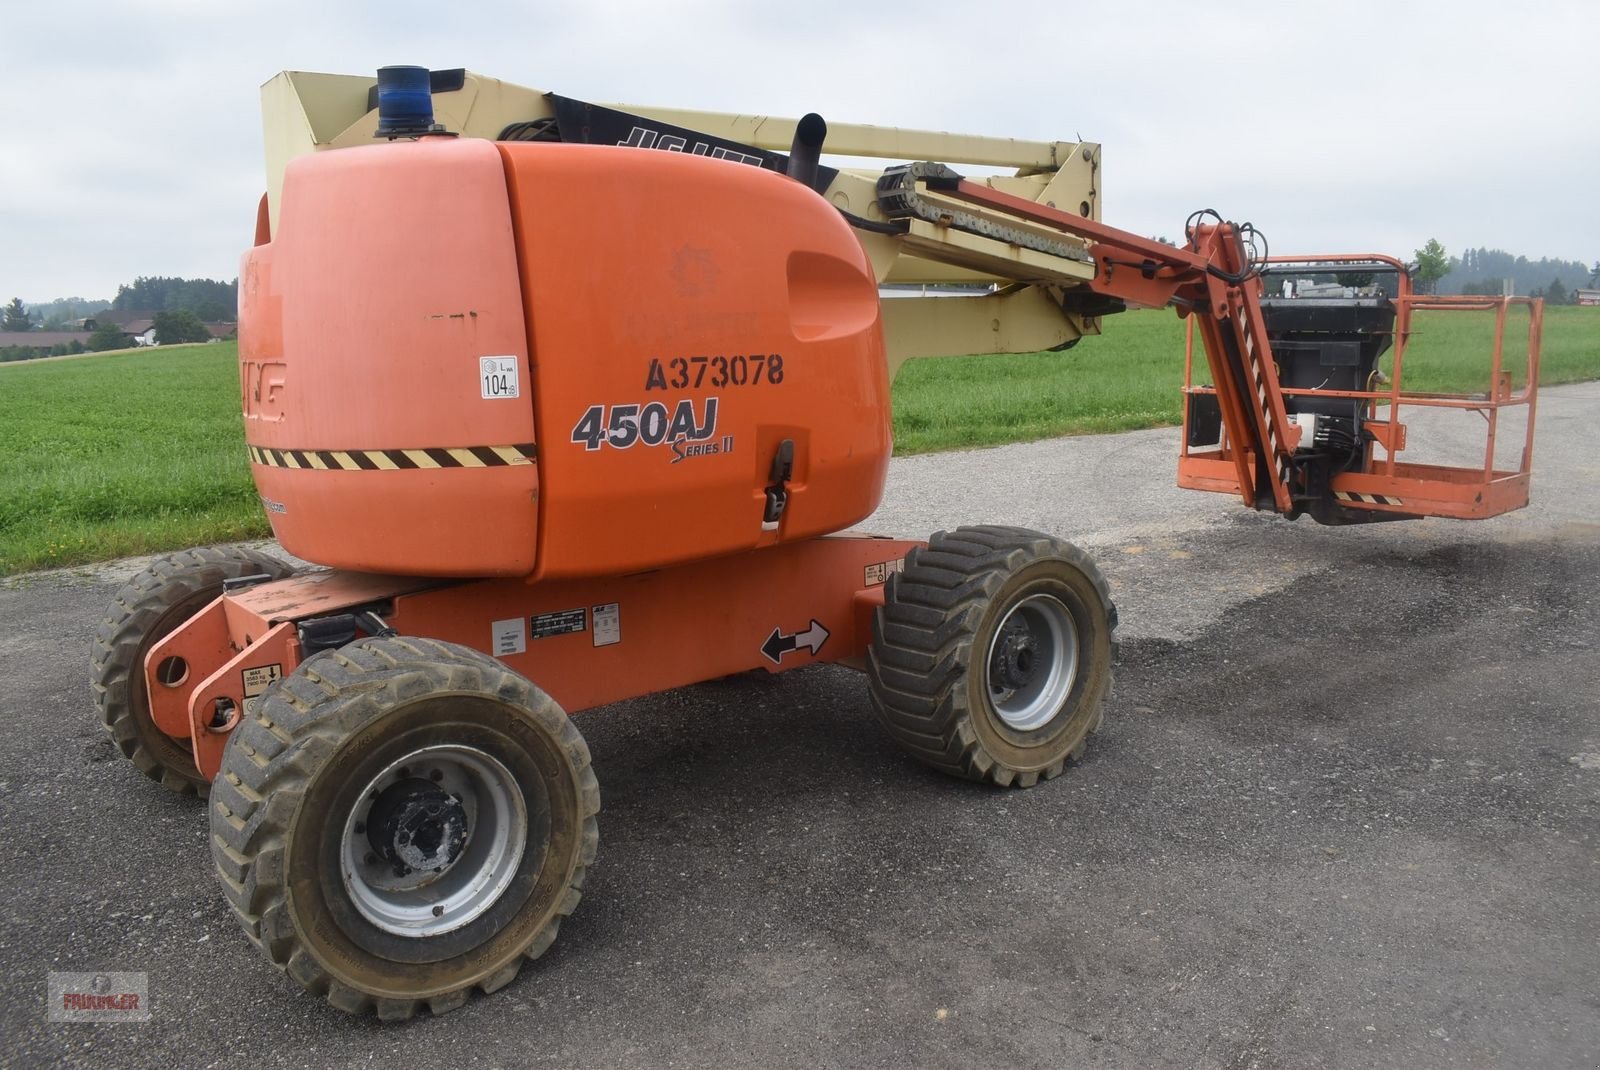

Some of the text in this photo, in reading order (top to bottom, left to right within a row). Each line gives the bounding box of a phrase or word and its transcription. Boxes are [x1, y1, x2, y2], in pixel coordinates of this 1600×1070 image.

[485, 374, 508, 395] 104
[645, 353, 785, 391] A373078
[571, 397, 718, 451] 450AJ
